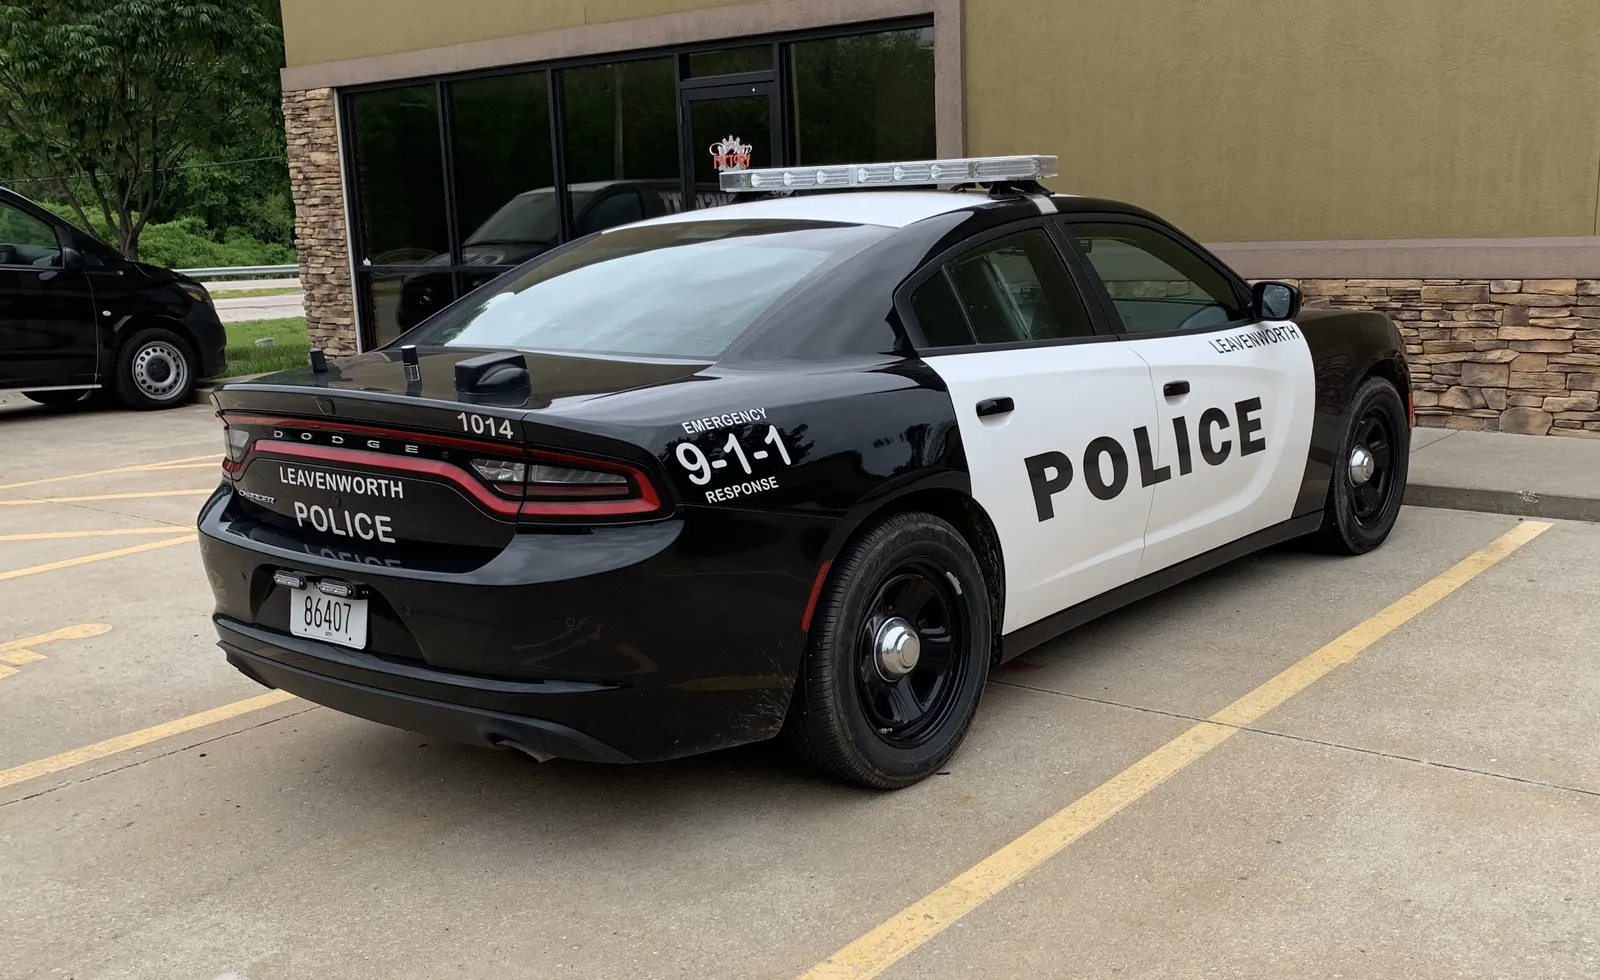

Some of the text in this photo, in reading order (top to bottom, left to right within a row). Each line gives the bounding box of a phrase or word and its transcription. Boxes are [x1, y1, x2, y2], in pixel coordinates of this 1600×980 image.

[1208, 325, 1299, 354] LEAVENWORTH
[457, 412, 514, 439] 1014
[682, 407, 767, 434] EMERGENCY
[273, 430, 419, 454] DODGE
[676, 425, 791, 485] 9-1-1
[1024, 397, 1266, 522] POLICE
[279, 466, 404, 499] LEAVENWORTH
[705, 476, 779, 504] RESPONSE
[293, 501, 396, 544] POLICE
[304, 596, 352, 634] 86407
